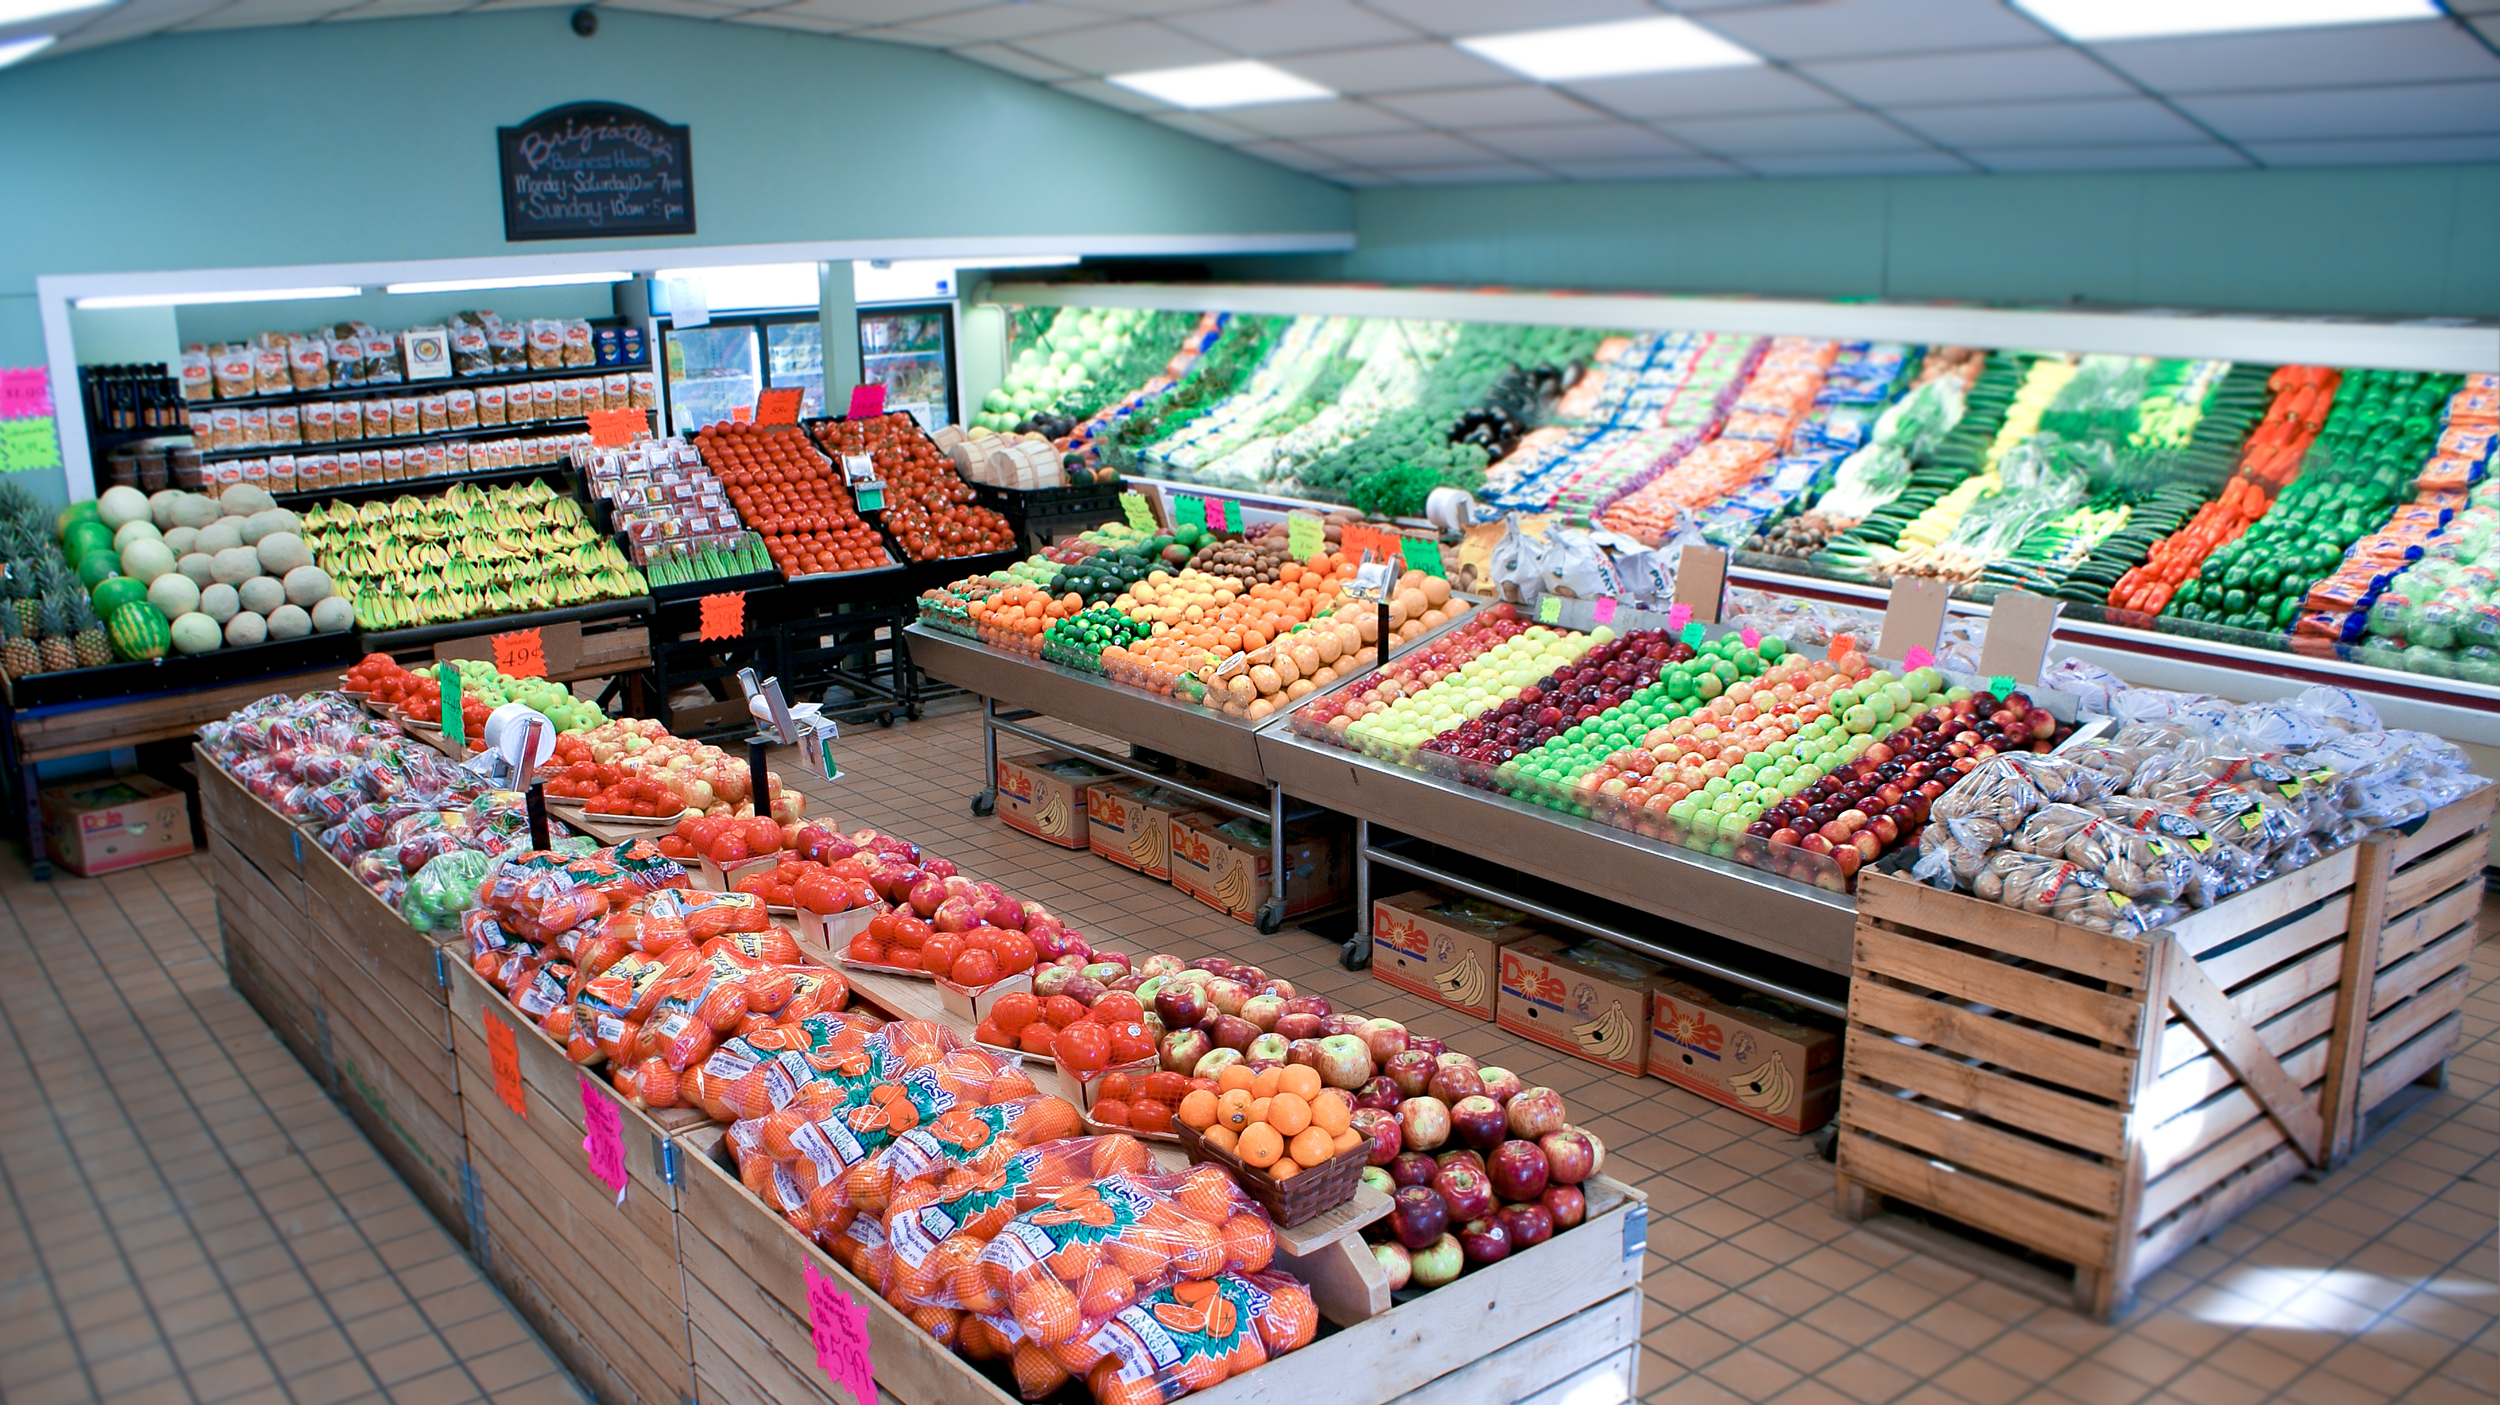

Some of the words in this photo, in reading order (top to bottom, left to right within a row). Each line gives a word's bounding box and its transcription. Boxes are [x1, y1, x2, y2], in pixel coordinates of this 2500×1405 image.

[552, 152, 612, 170] Business
[614, 149, 650, 169] Hours
[529, 194, 603, 225] Sunday
[999, 763, 1031, 798] Dole
[83, 810, 123, 829] Dole
[1089, 790, 1125, 826] Dole
[1171, 823, 1210, 864] Dole
[1374, 906, 1429, 954] Dole
[1502, 952, 1567, 1004] Dole
[1530, 1018, 1564, 1038] BANANAS
[1654, 994, 1724, 1052] Dole
[904, 1066, 955, 1115] Fresh
[1683, 1065, 1721, 1087] BANANAS
[1122, 1313, 1169, 1363] ORANGES
[1137, 1313, 1170, 1351] NAVEL
